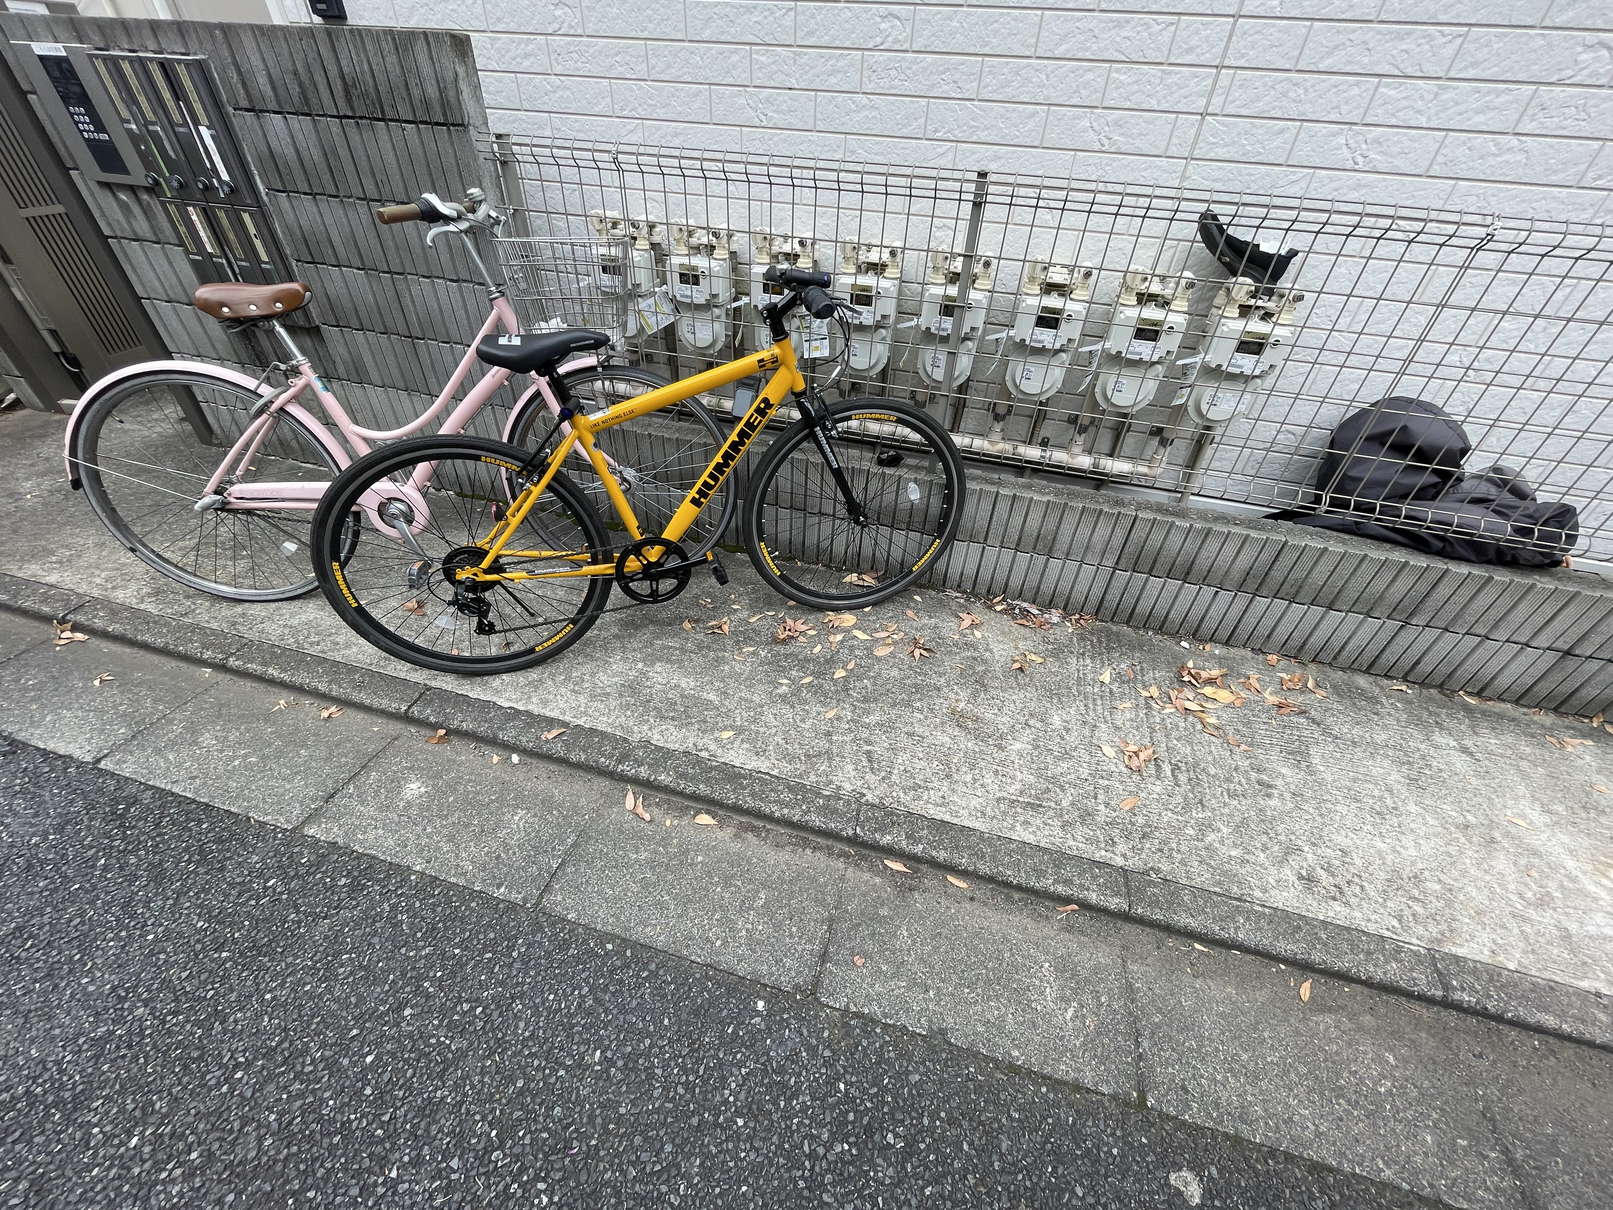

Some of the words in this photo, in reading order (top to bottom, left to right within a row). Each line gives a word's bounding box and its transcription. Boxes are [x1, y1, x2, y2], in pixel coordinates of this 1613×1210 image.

[601, 412, 623, 425] NOTHING
[852, 412, 898, 422] HUMMER
[689, 396, 775, 509] HUMMER
[331, 561, 358, 608] HUMMER
[534, 623, 574, 653] HUMMER
